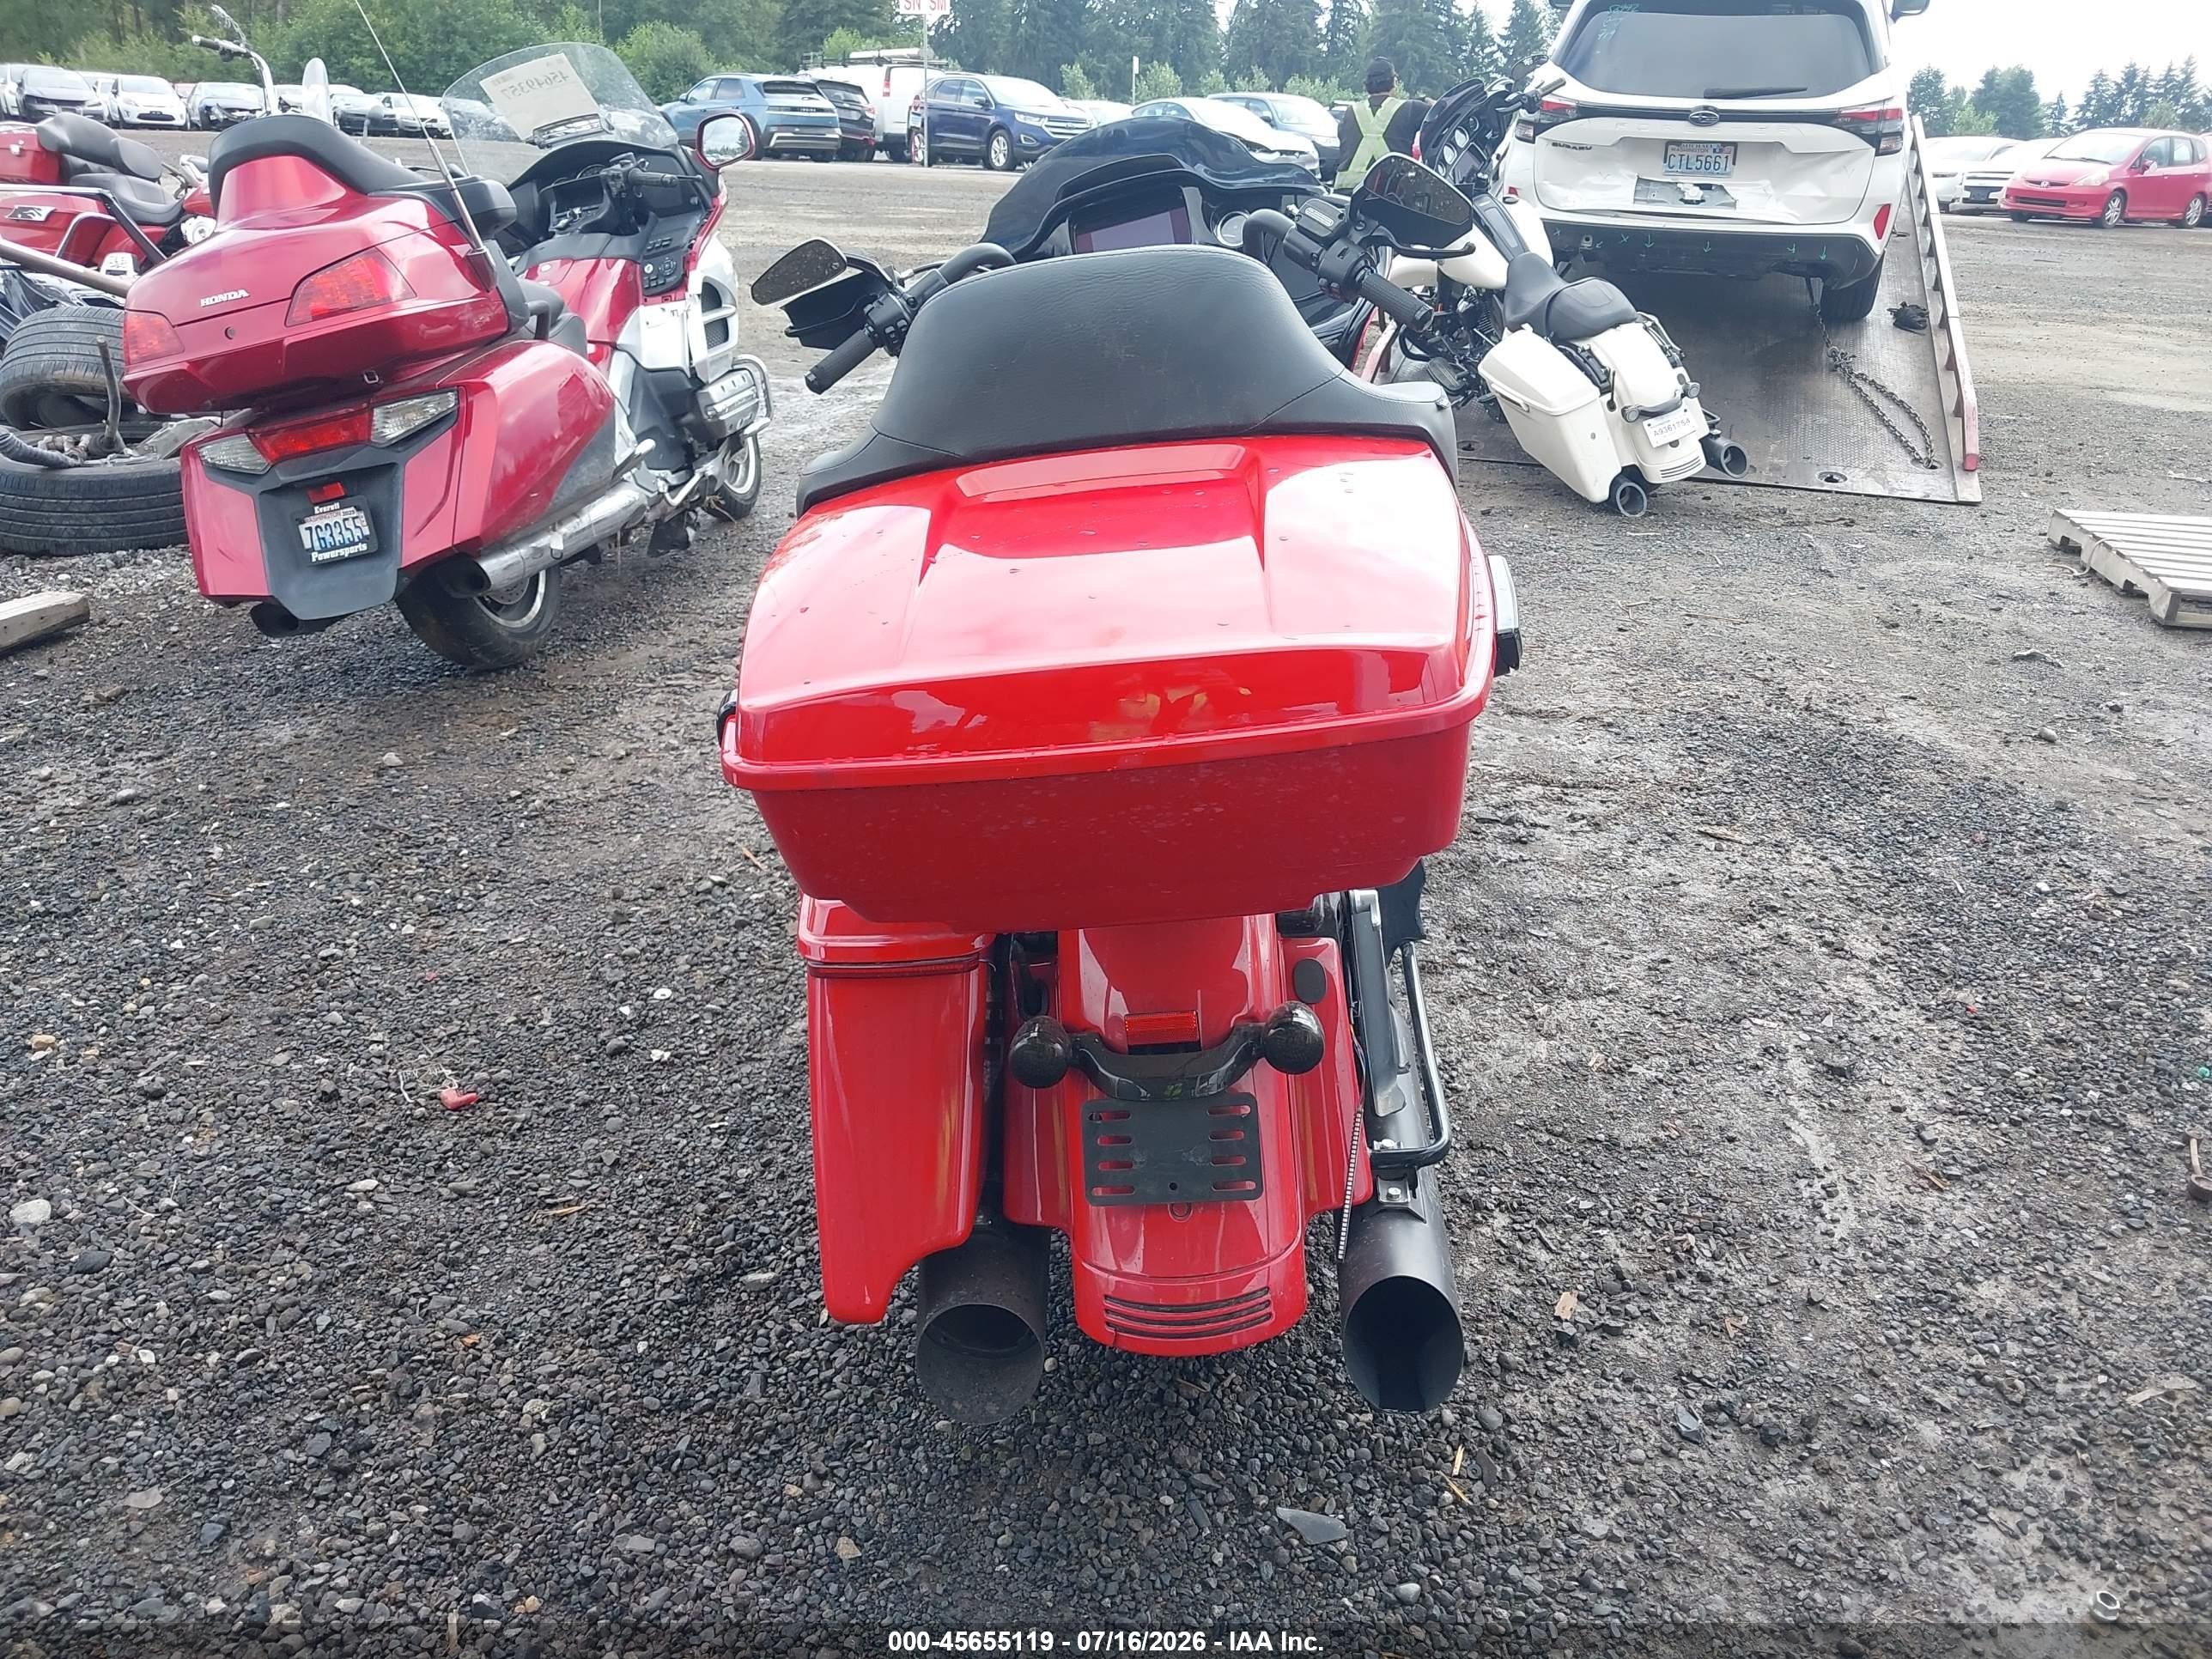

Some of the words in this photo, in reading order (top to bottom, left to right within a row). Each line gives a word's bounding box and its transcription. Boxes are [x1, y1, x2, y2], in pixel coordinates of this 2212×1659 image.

[1552, 142, 1592, 150] SUBARU
[1668, 154, 1729, 171] CTL5661
[200, 289, 249, 307] HONDA
[311, 543, 368, 562] Powersports
